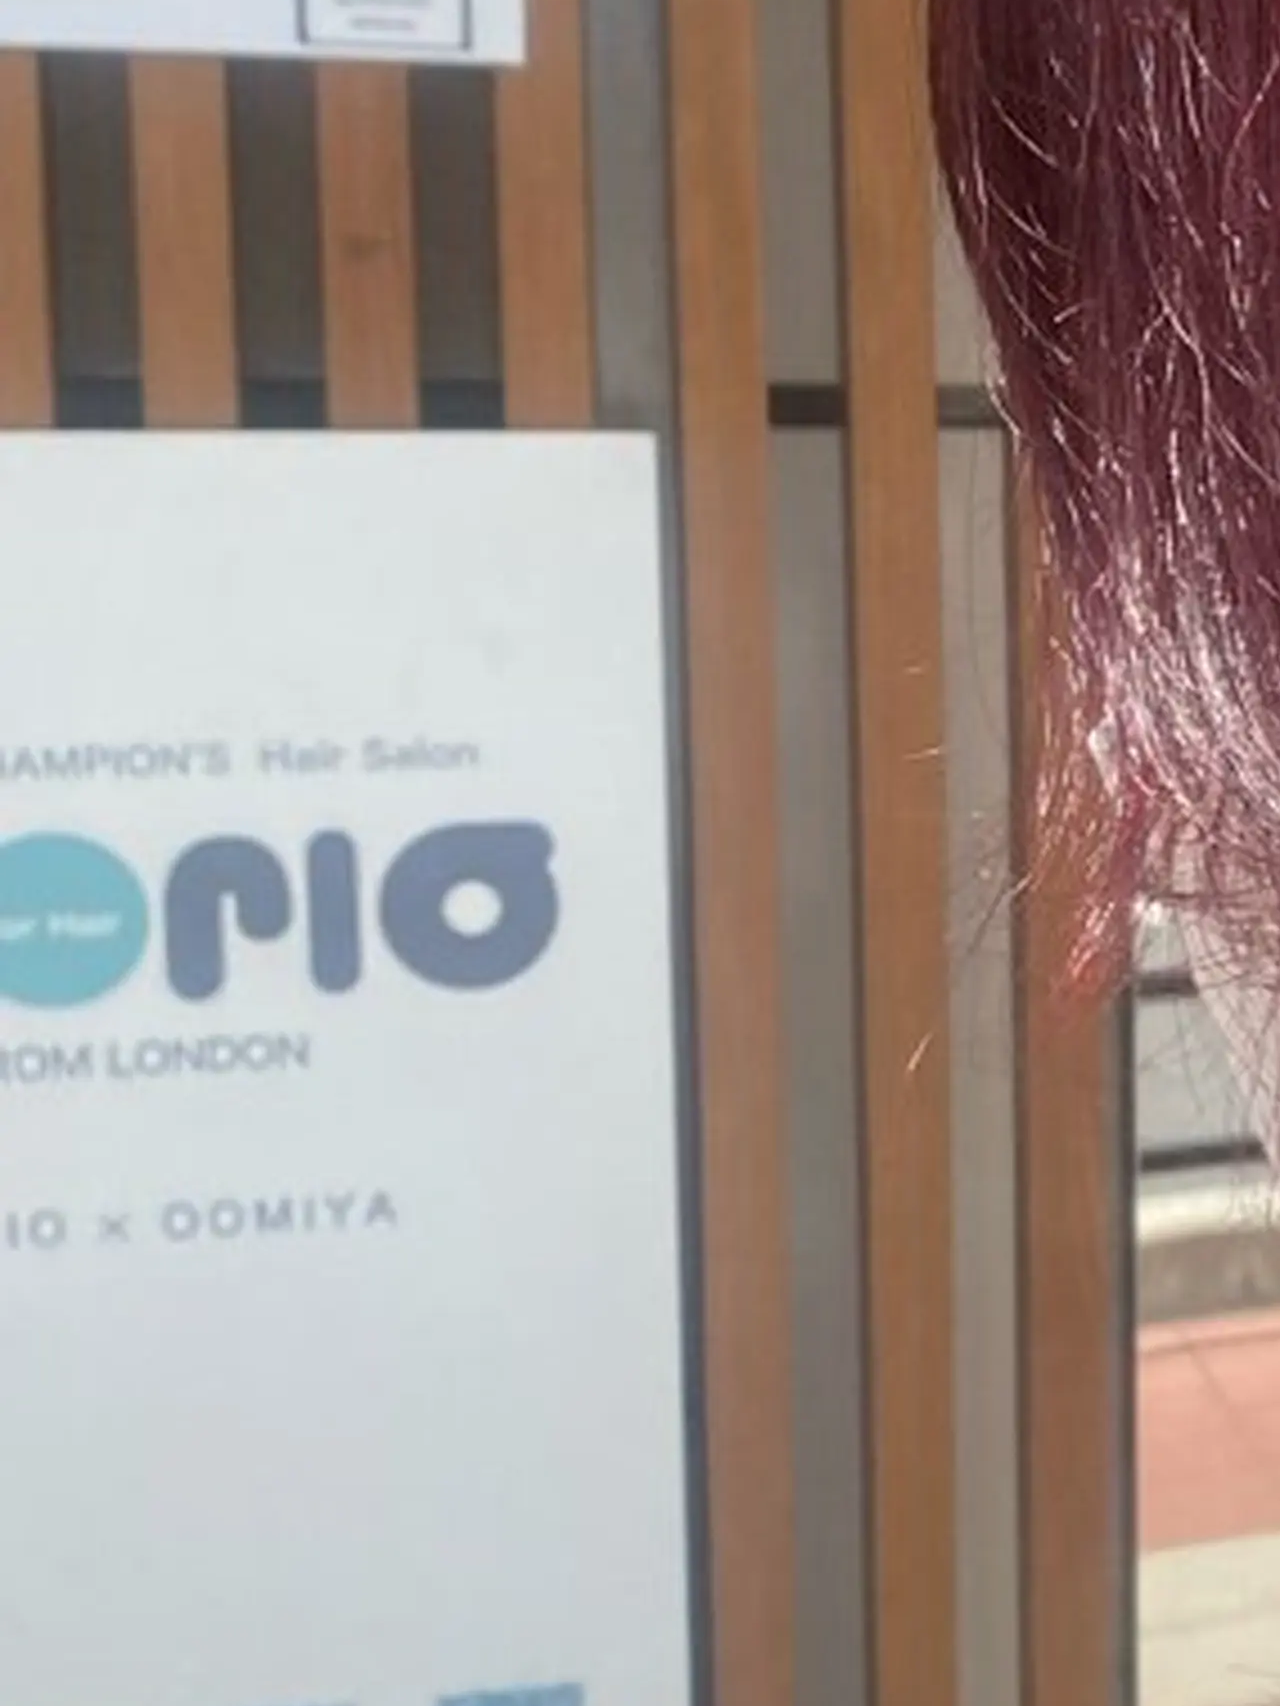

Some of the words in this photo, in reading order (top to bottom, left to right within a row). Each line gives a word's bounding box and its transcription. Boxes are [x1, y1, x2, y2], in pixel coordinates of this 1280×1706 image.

[259, 737, 345, 775] Hair
[362, 733, 480, 772] Salon
[106, 1031, 312, 1079] LONDON
[161, 1188, 399, 1243] OOMIYA
